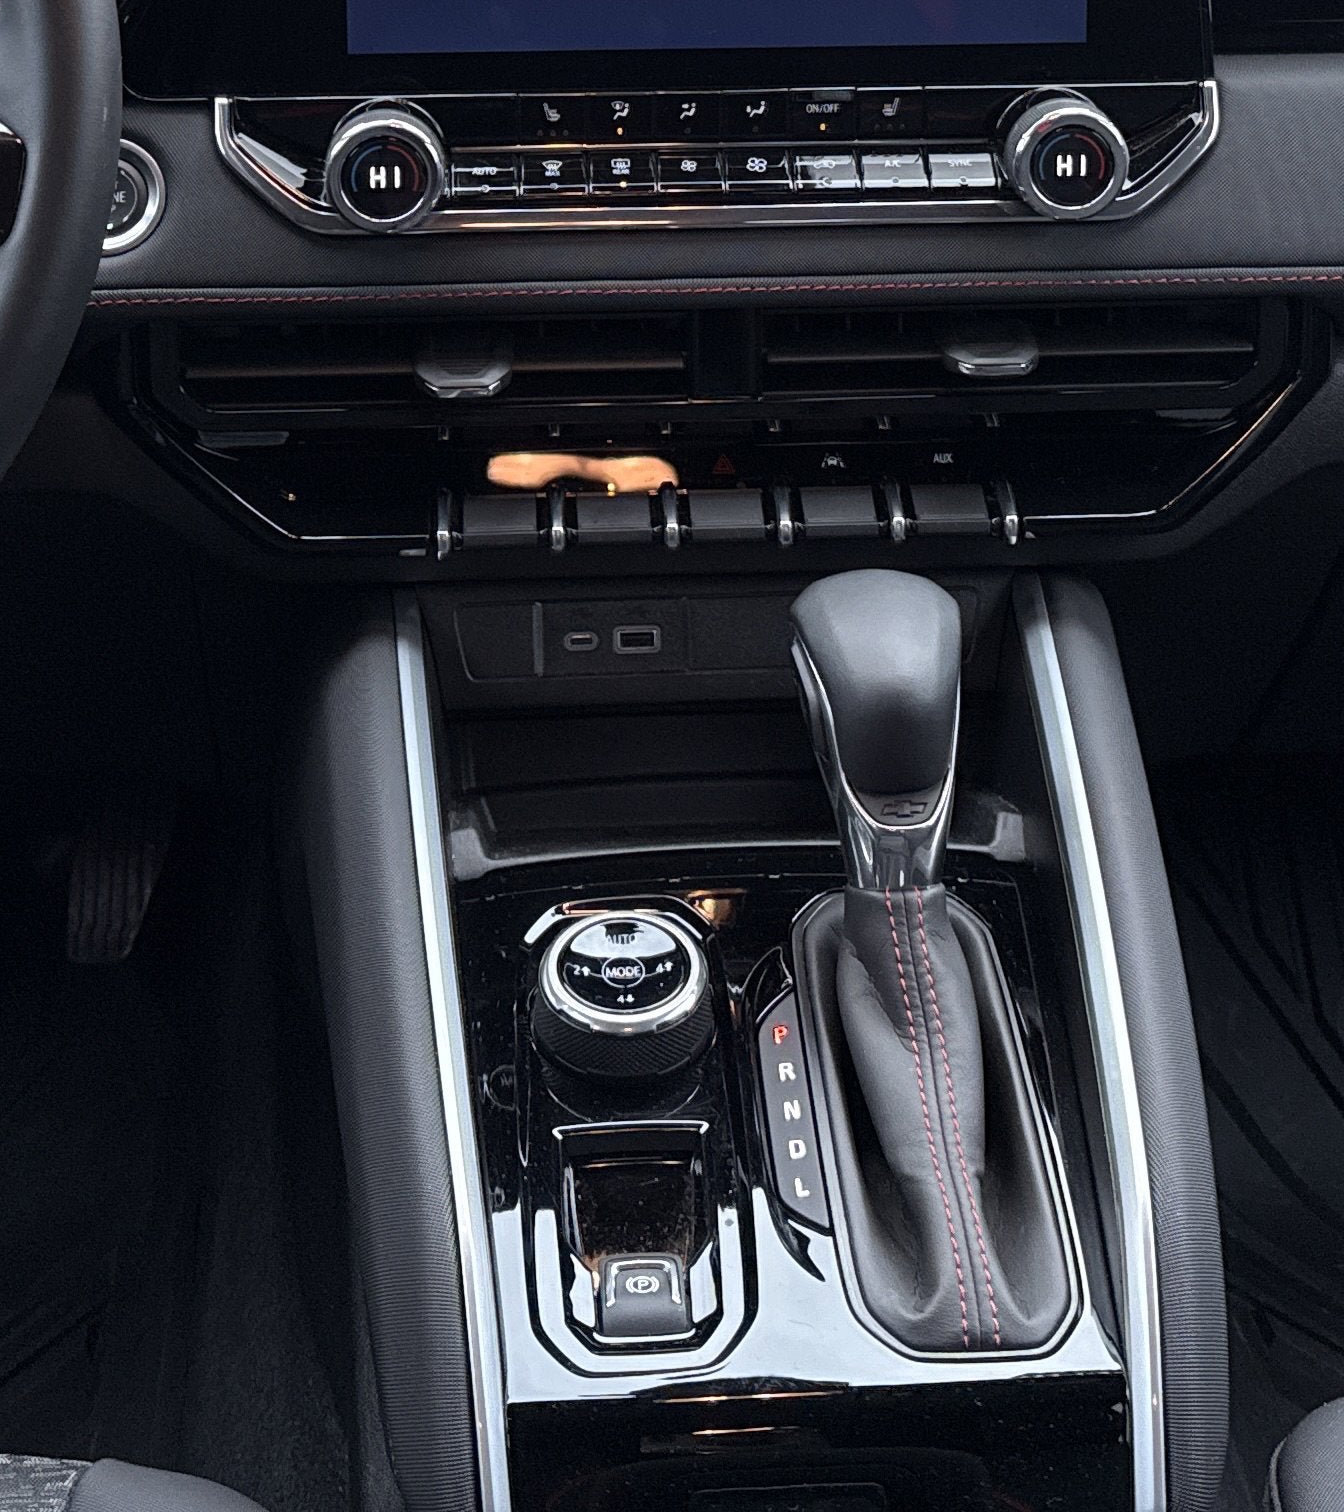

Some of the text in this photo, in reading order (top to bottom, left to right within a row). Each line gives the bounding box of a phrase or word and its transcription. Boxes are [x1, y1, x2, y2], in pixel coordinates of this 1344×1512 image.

[806, 103, 840, 114] ON/OFF
[884, 159, 901, 168] A/C
[948, 159, 973, 167] SYNC
[1056, 154, 1087, 177] HI
[369, 165, 401, 189] HI
[472, 167, 497, 176] AUTO
[933, 453, 954, 463] AUX
[606, 934, 636, 945] AUTO
[605, 965, 641, 978] MODE
[772, 1025, 789, 1044] P
[778, 1062, 796, 1082] R
[783, 1099, 801, 1121] N
[788, 1139, 807, 1160] D
[794, 1177, 810, 1198] L
